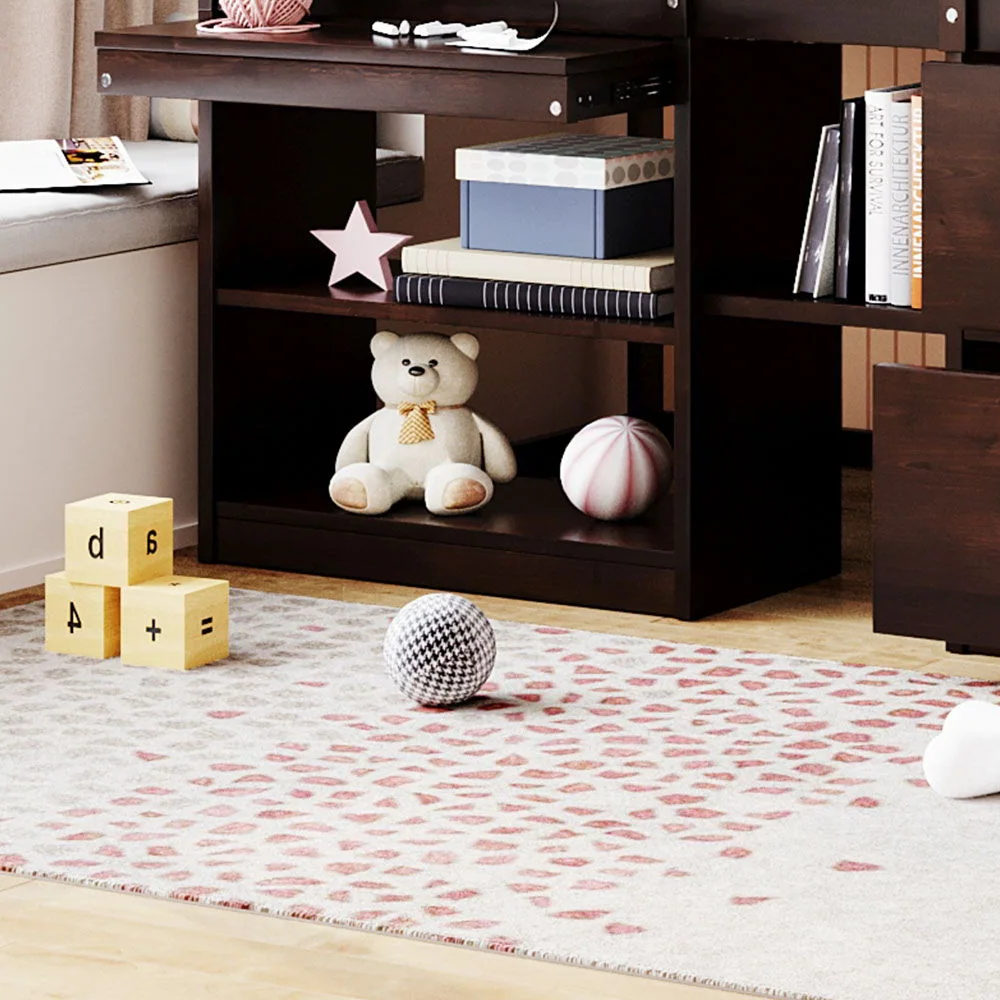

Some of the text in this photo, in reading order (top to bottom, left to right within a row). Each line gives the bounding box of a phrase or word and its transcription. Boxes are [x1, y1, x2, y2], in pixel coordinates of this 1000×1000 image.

[868, 104, 885, 215] ART FOR SURVIVAL
[892, 114, 910, 276] INNENARCHITEKTUR
